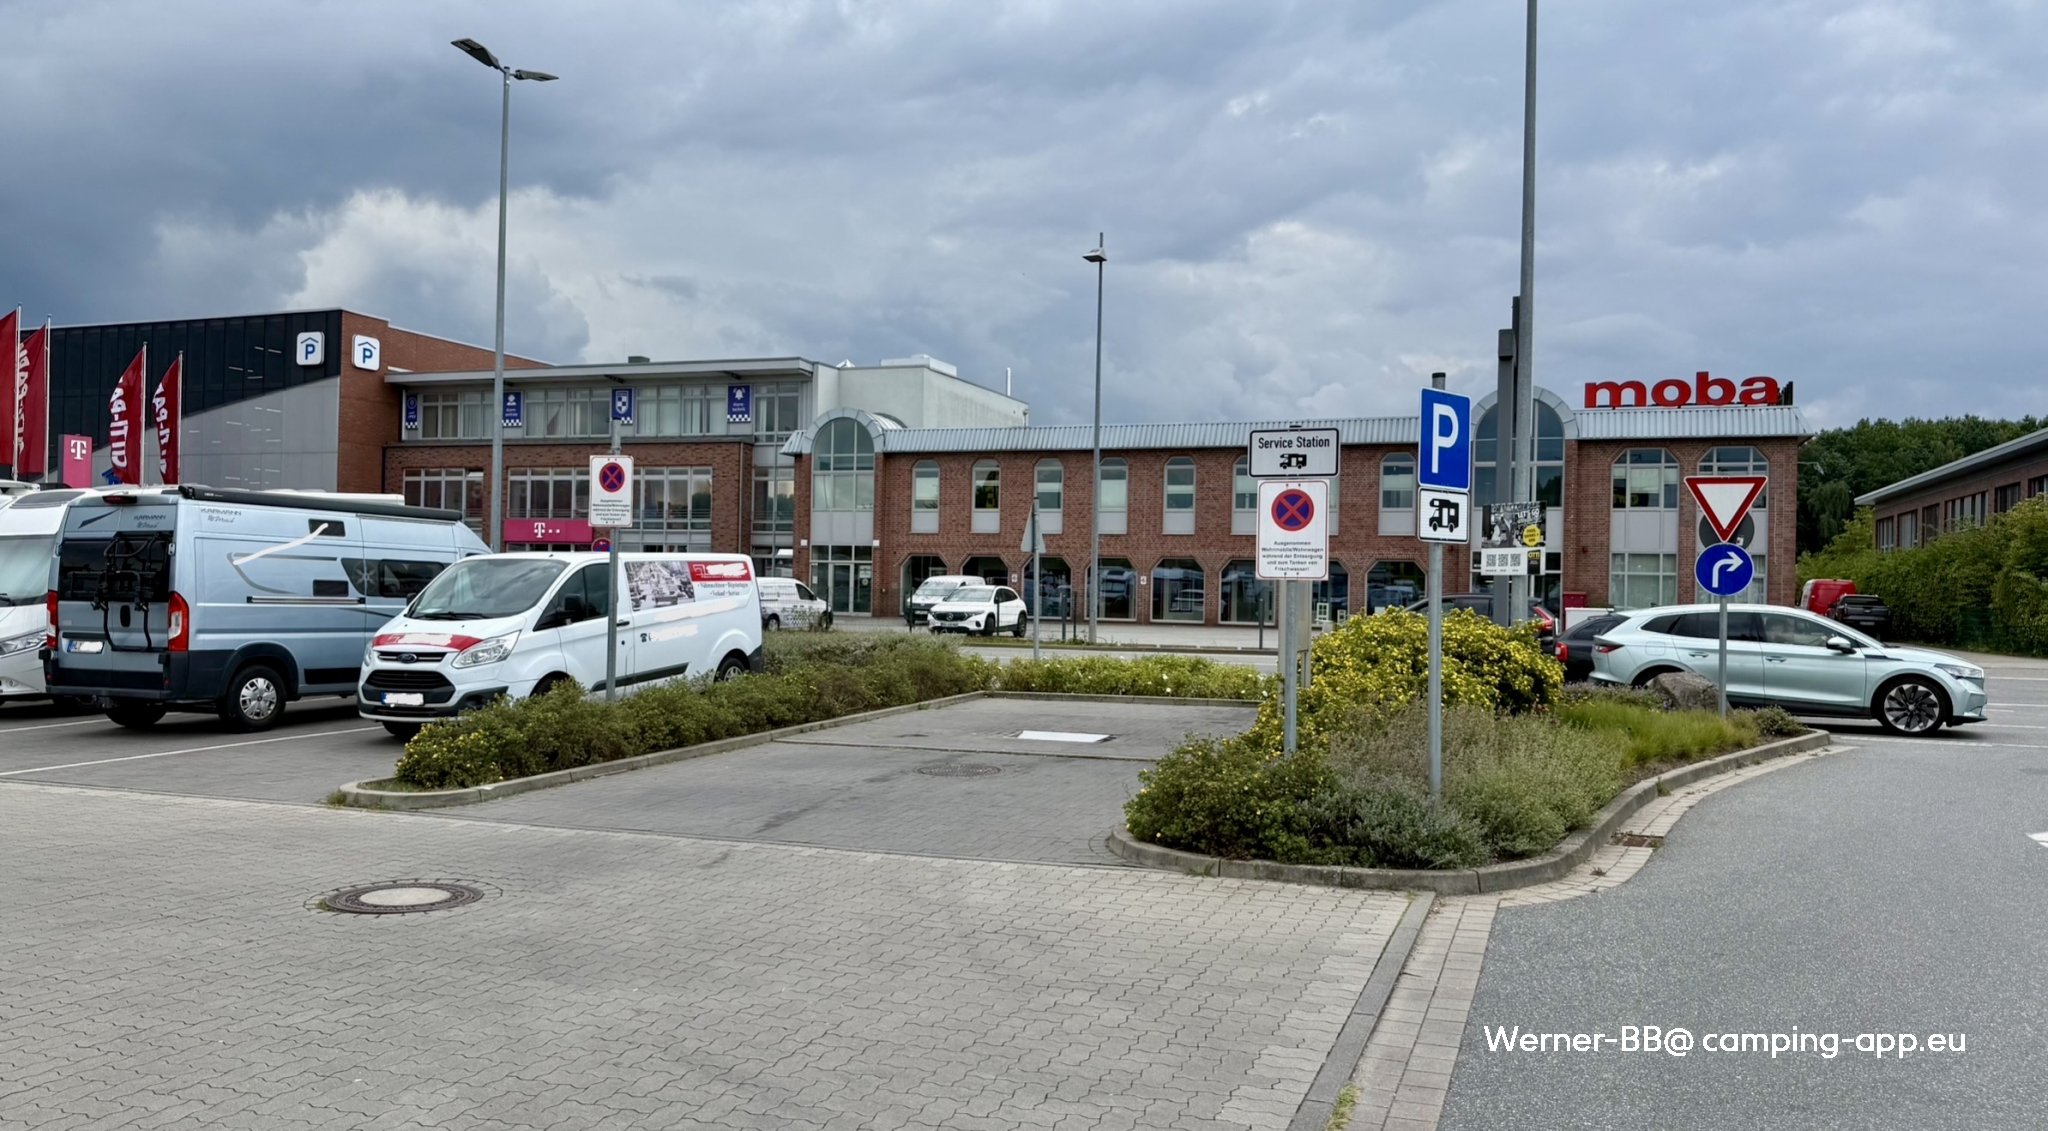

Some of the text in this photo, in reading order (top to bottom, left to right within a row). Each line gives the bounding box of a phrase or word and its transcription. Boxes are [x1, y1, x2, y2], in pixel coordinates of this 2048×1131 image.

[305, 343, 316, 360] P
[362, 347, 374, 364] P
[1584, 371, 1779, 408] moba
[1258, 436, 1330, 449] Service Station
[1431, 402, 1459, 474] P
